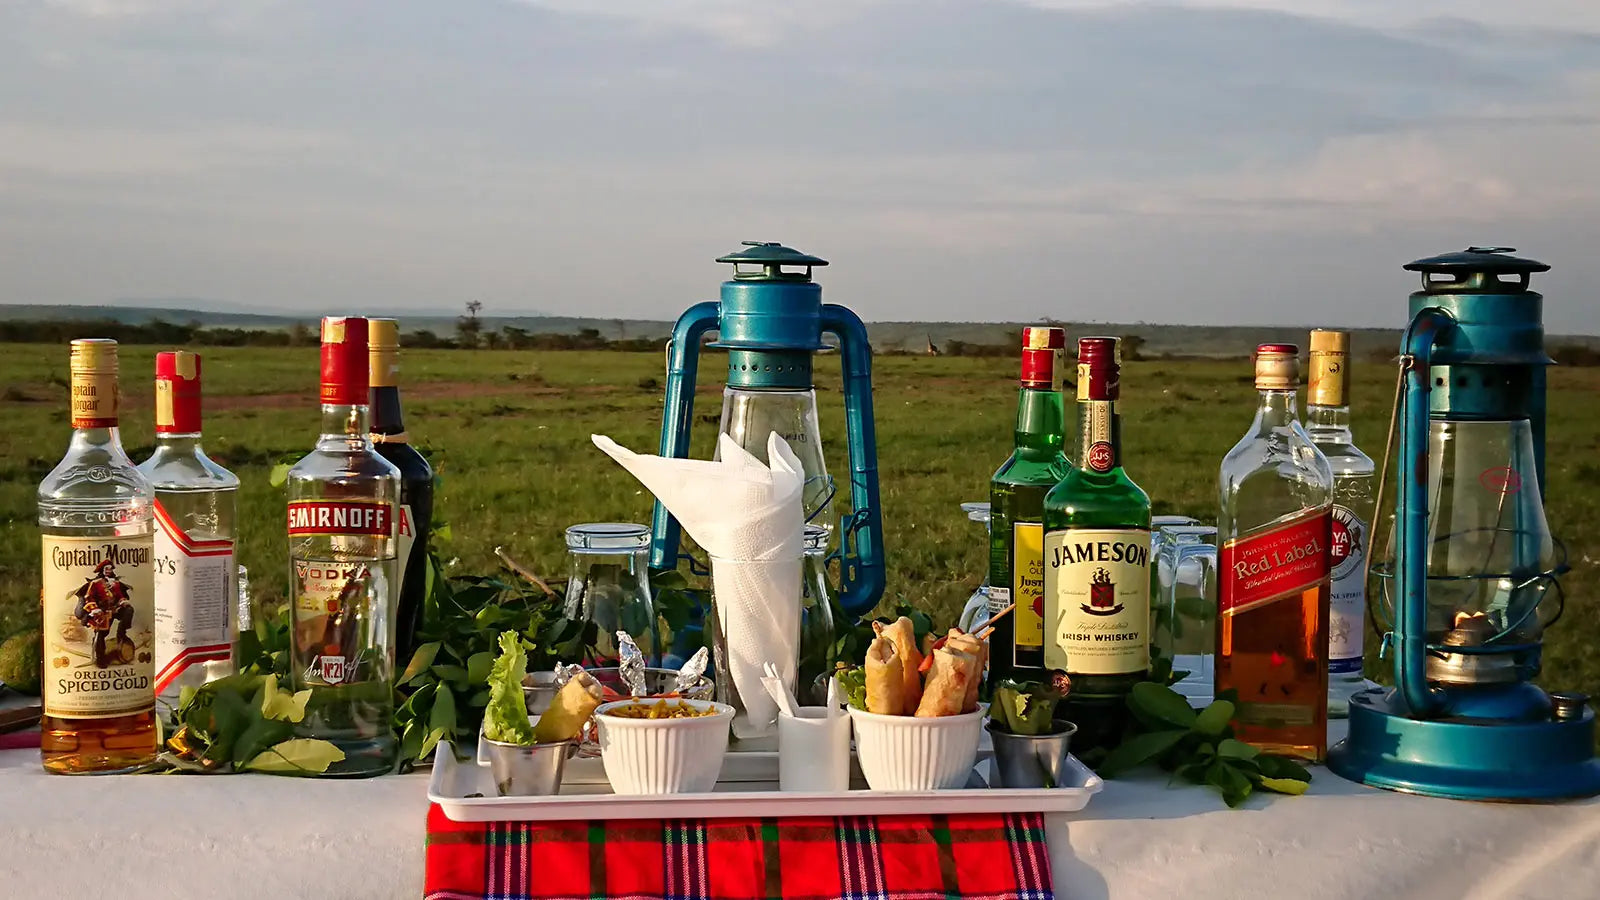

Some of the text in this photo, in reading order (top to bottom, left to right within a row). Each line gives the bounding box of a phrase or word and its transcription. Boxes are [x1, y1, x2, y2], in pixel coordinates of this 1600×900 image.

[73, 383, 97, 398] aptain
[289, 507, 385, 529] SMIRNOFF
[1333, 532, 1349, 543] YA
[52, 544, 150, 571] Captain Morgan
[1051, 542, 1148, 568] JAMESON
[1233, 537, 1322, 580] Red Label
[154, 555, 176, 575] Y'S
[296, 565, 371, 580] VODKA
[1019, 576, 1043, 589] JUST
[1062, 632, 1139, 642] IRISH WHISKEY
[74, 667, 137, 680] ORIGINAL
[58, 675, 149, 695] SPICED GOLD
